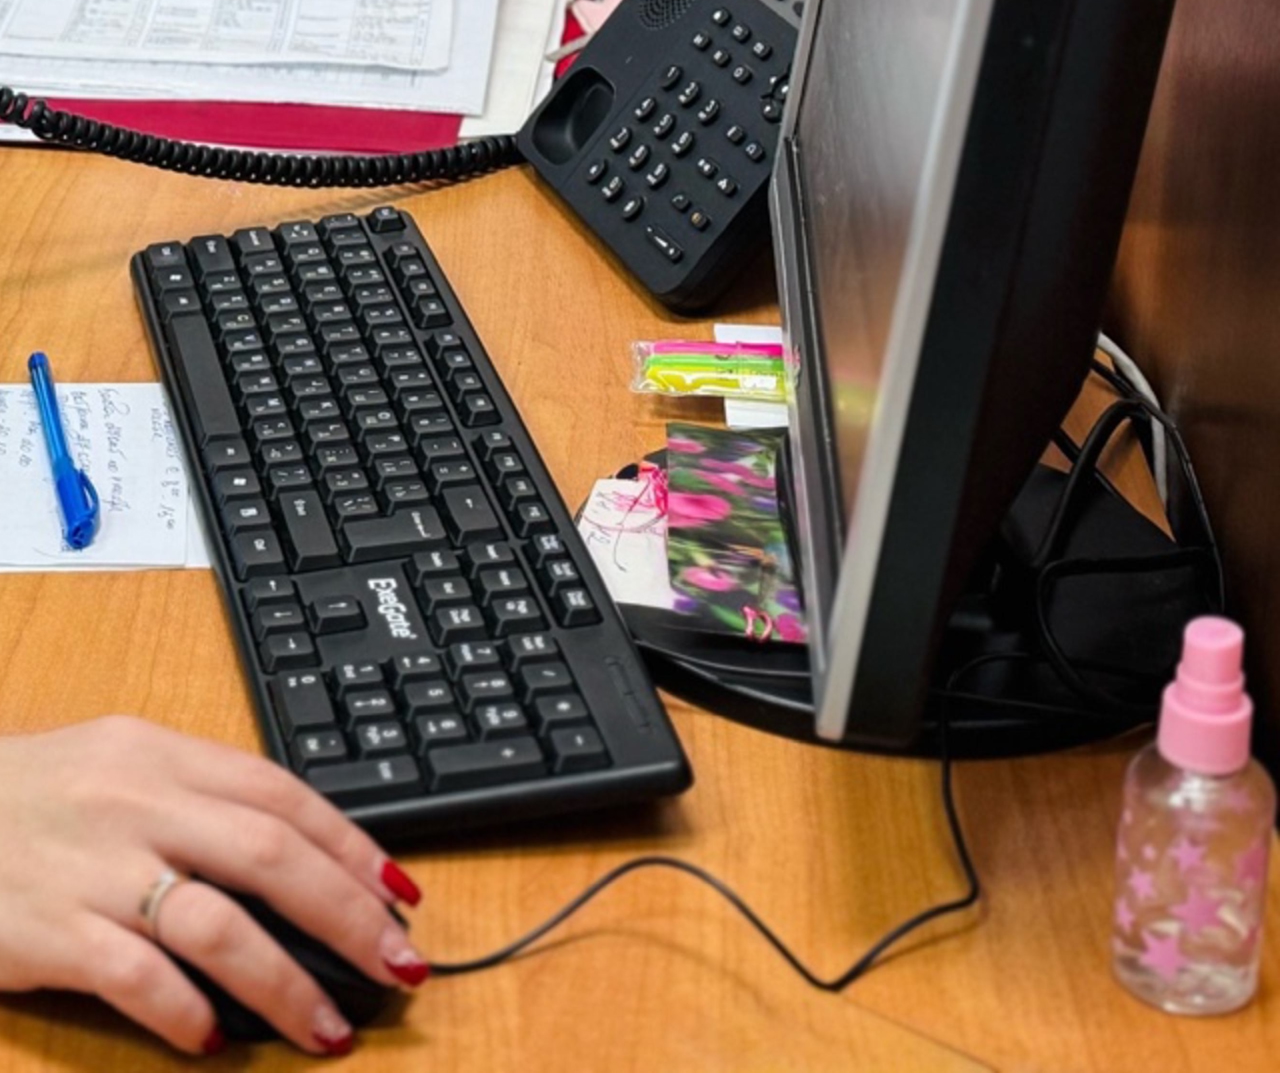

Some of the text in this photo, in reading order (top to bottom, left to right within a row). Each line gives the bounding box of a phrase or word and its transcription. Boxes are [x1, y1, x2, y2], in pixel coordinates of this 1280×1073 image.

[368, 578, 411, 638] ExeGate
[301, 675, 316, 684] 0
[428, 688, 444, 697] 5
